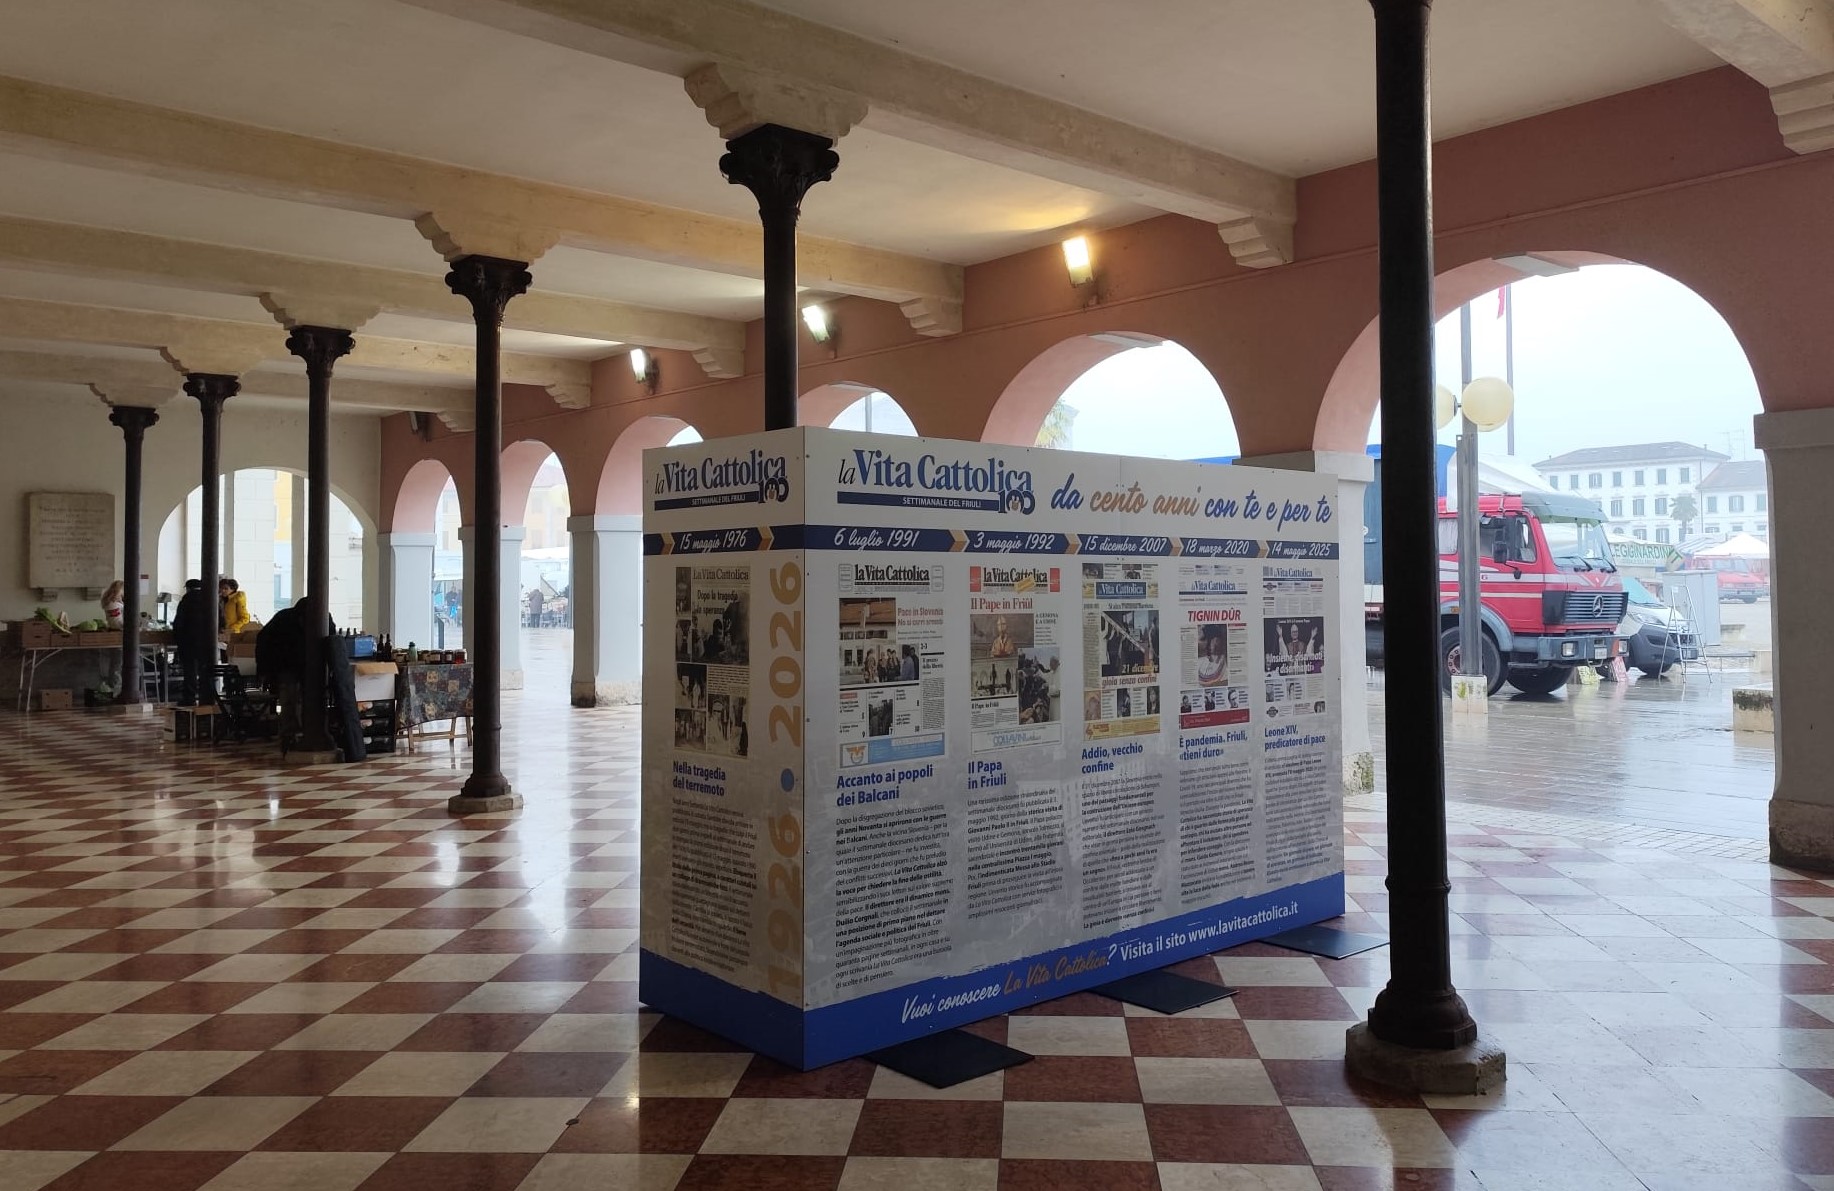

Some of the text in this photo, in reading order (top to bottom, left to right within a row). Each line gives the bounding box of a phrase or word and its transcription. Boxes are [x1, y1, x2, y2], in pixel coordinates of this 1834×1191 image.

[663, 461, 699, 492] Vita
[701, 449, 787, 489] Cattolica
[852, 449, 914, 489] Vita
[918, 454, 1034, 493] Cattolica
[902, 497, 982, 509] SETTIMANALE DEL FRIULI
[1051, 473, 1332, 532] da cento anni con te e per te
[680, 530, 749, 553] 15 maggio 1976
[834, 528, 921, 552] 6 luglio 1991
[974, 532, 1055, 554] 3 maggio 1992
[1085, 535, 1167, 552] 15 dicembre 2007
[1186, 539, 1249, 557] 18 marzo 2020
[1272, 543, 1330, 559] 14 maggio 2025
[716, 569, 749, 580] Cattolica
[886, 565, 930, 581] Cattolica
[1288, 568, 1313, 577] Cattolica
[1208, 580, 1236, 591] Cattolica
[971, 598, 978, 610] Il
[980, 597, 1001, 612] Pape
[1002, 597, 1011, 609] in
[1188, 610, 1221, 622] TIGNIN
[769, 561, 801, 747] 2026
[1185, 733, 1225, 749] pandemia.
[1226, 730, 1248, 743] Friuli,
[1264, 724, 1298, 738] Leone XIV,
[1082, 743, 1144, 760] Addio, vecchio
[1264, 735, 1326, 752] predicatore di pace
[673, 760, 726, 781] Nella tragedia
[836, 763, 933, 789] Accanto ai popoli
[968, 761, 1003, 775] Il Papa
[1082, 761, 1114, 774] confine
[673, 776, 725, 797] del terremoto
[968, 773, 1007, 790] in Friuli
[836, 786, 900, 807] dei Balcani
[901, 994, 935, 1024] Vuoi
[937, 983, 1002, 1012] conoscere
[1004, 973, 1022, 995] La
[1026, 964, 1050, 988] Vita
[1120, 941, 1154, 962] Visita
[1156, 936, 1163, 951] il
[1165, 932, 1187, 950] sito
[1188, 901, 1299, 942] www.lavitacattolica.it
